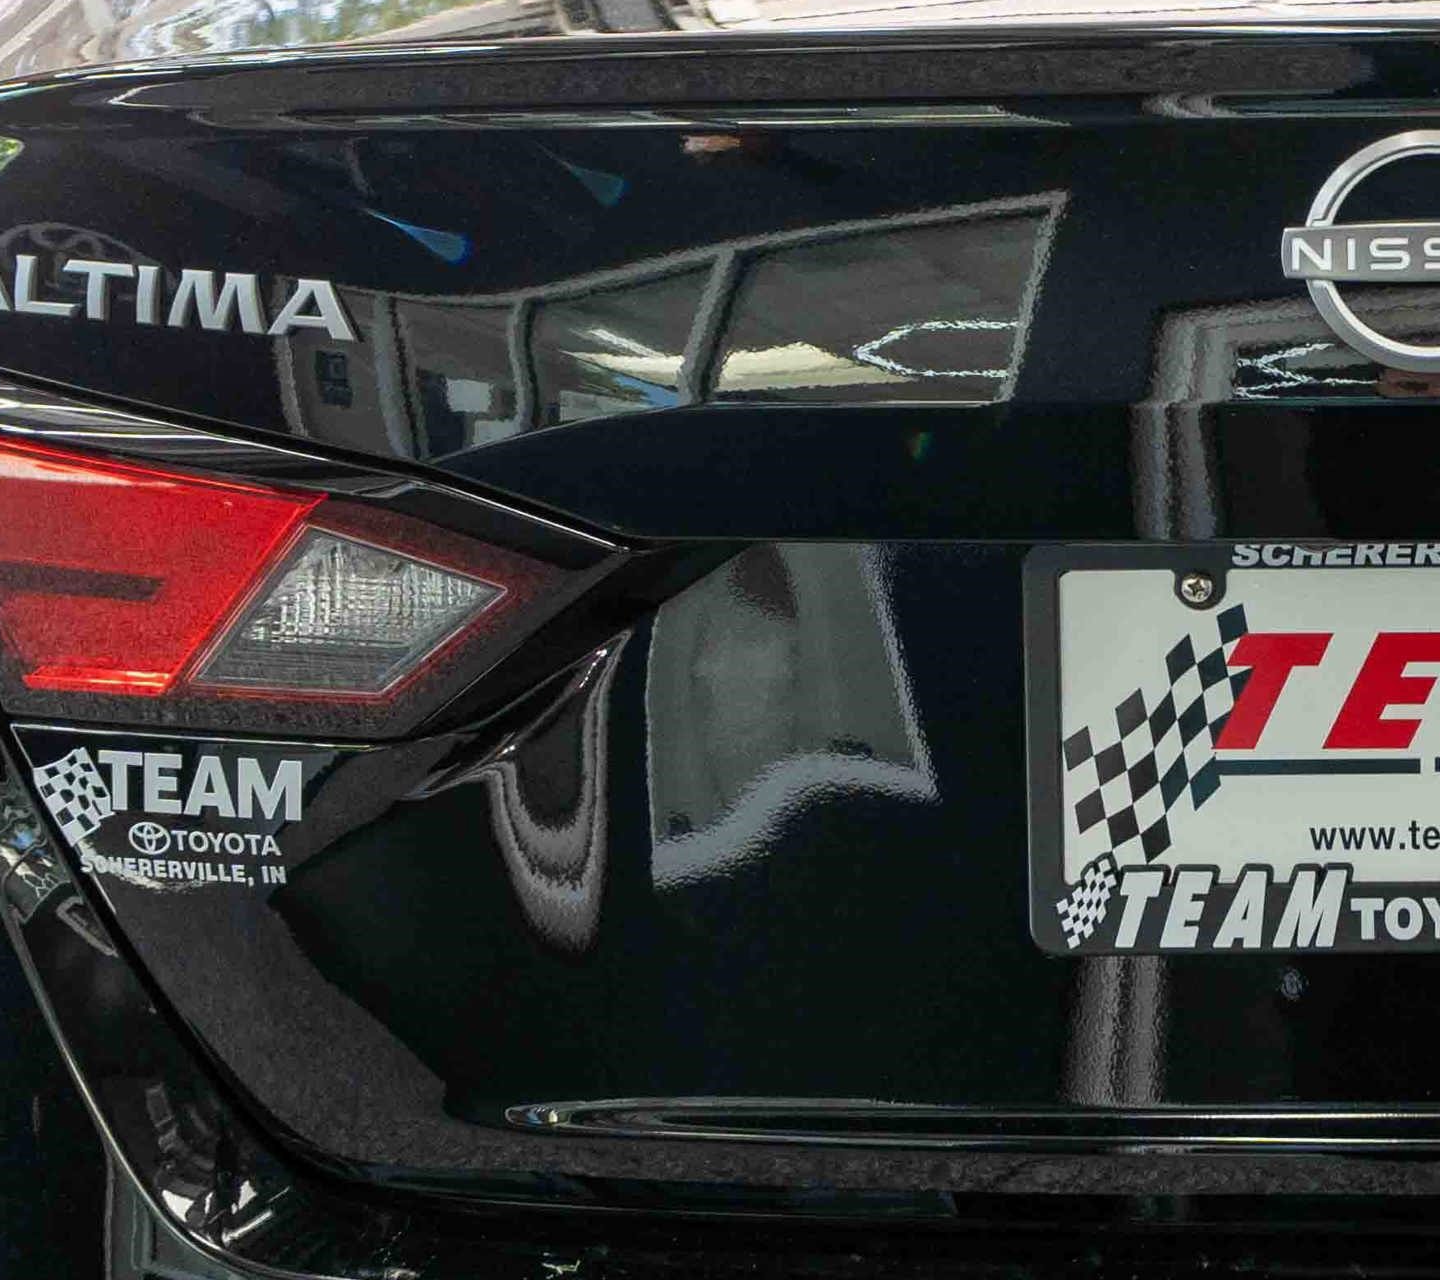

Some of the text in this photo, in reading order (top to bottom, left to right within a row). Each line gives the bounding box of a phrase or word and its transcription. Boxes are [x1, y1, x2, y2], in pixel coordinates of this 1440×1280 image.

[98, 749, 303, 821] TEAM
[170, 829, 282, 857] TOYOTA
[80, 855, 287, 886] SCHERERVILLE, IN
[1114, 869, 1348, 949] TEAM
